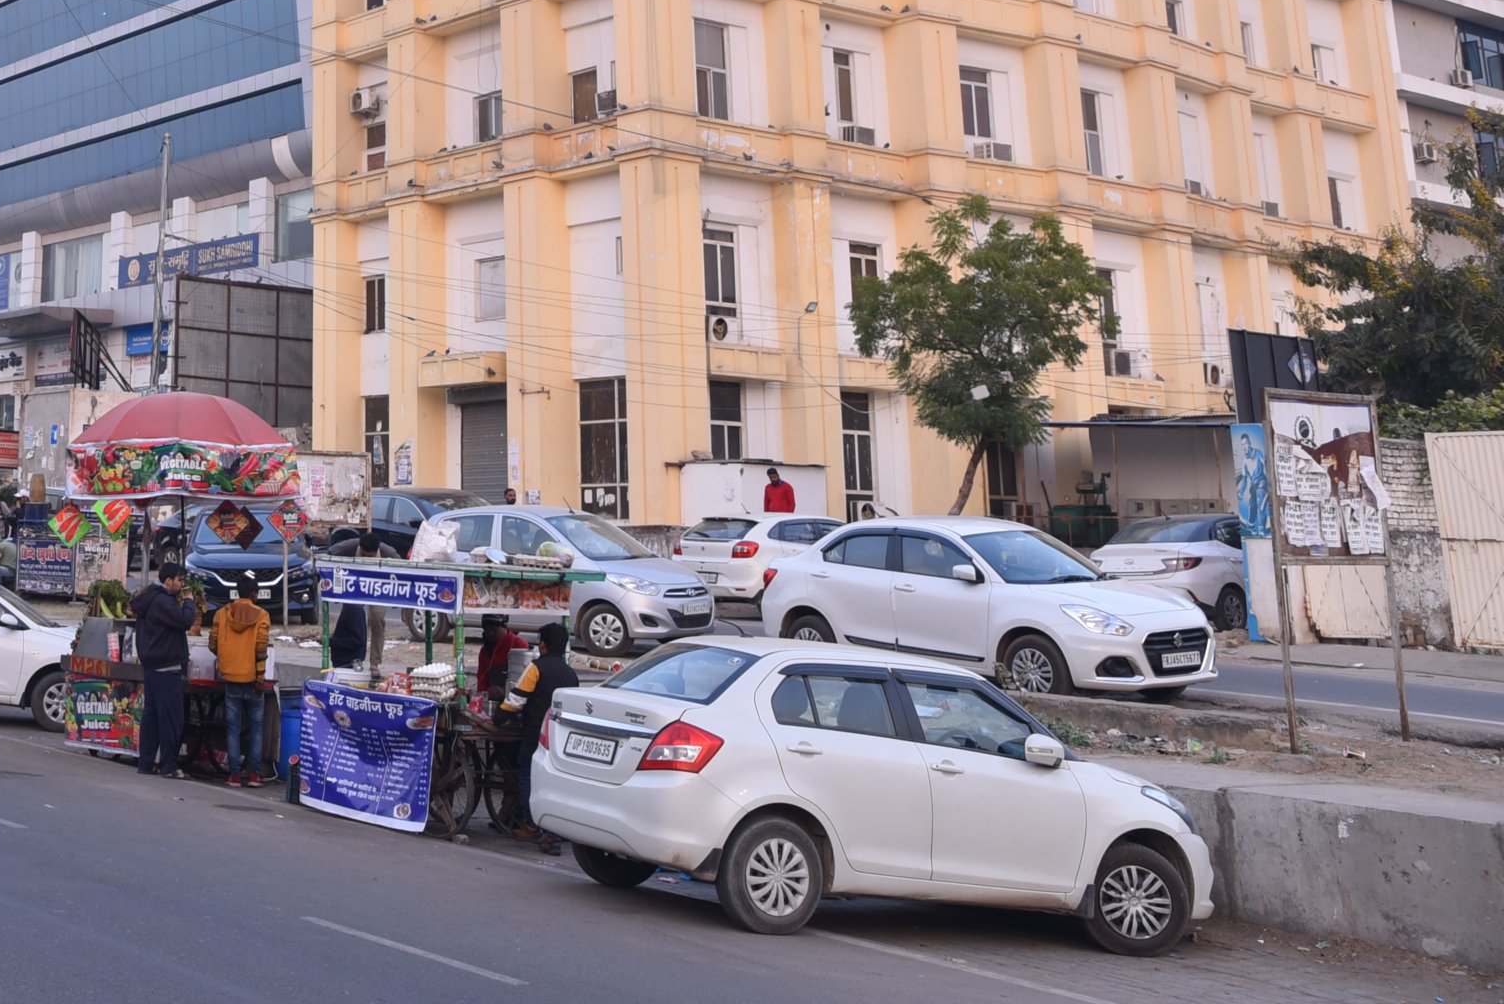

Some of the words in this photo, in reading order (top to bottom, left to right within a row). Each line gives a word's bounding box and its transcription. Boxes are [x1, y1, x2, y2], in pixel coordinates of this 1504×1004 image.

[198, 246, 215, 264] SUKH
[160, 459, 206, 471] VEGETABLE
[166, 472, 202, 480] Juice
[359, 574, 411, 598] चाइनीज
[415, 582, 438, 606] फूड
[77, 701, 114, 715] VEGETABLE
[329, 690, 344, 706] हॉट
[346, 696, 381, 713] चाइनीज
[384, 702, 403, 719] फूड
[81, 719, 110, 730] Juice
